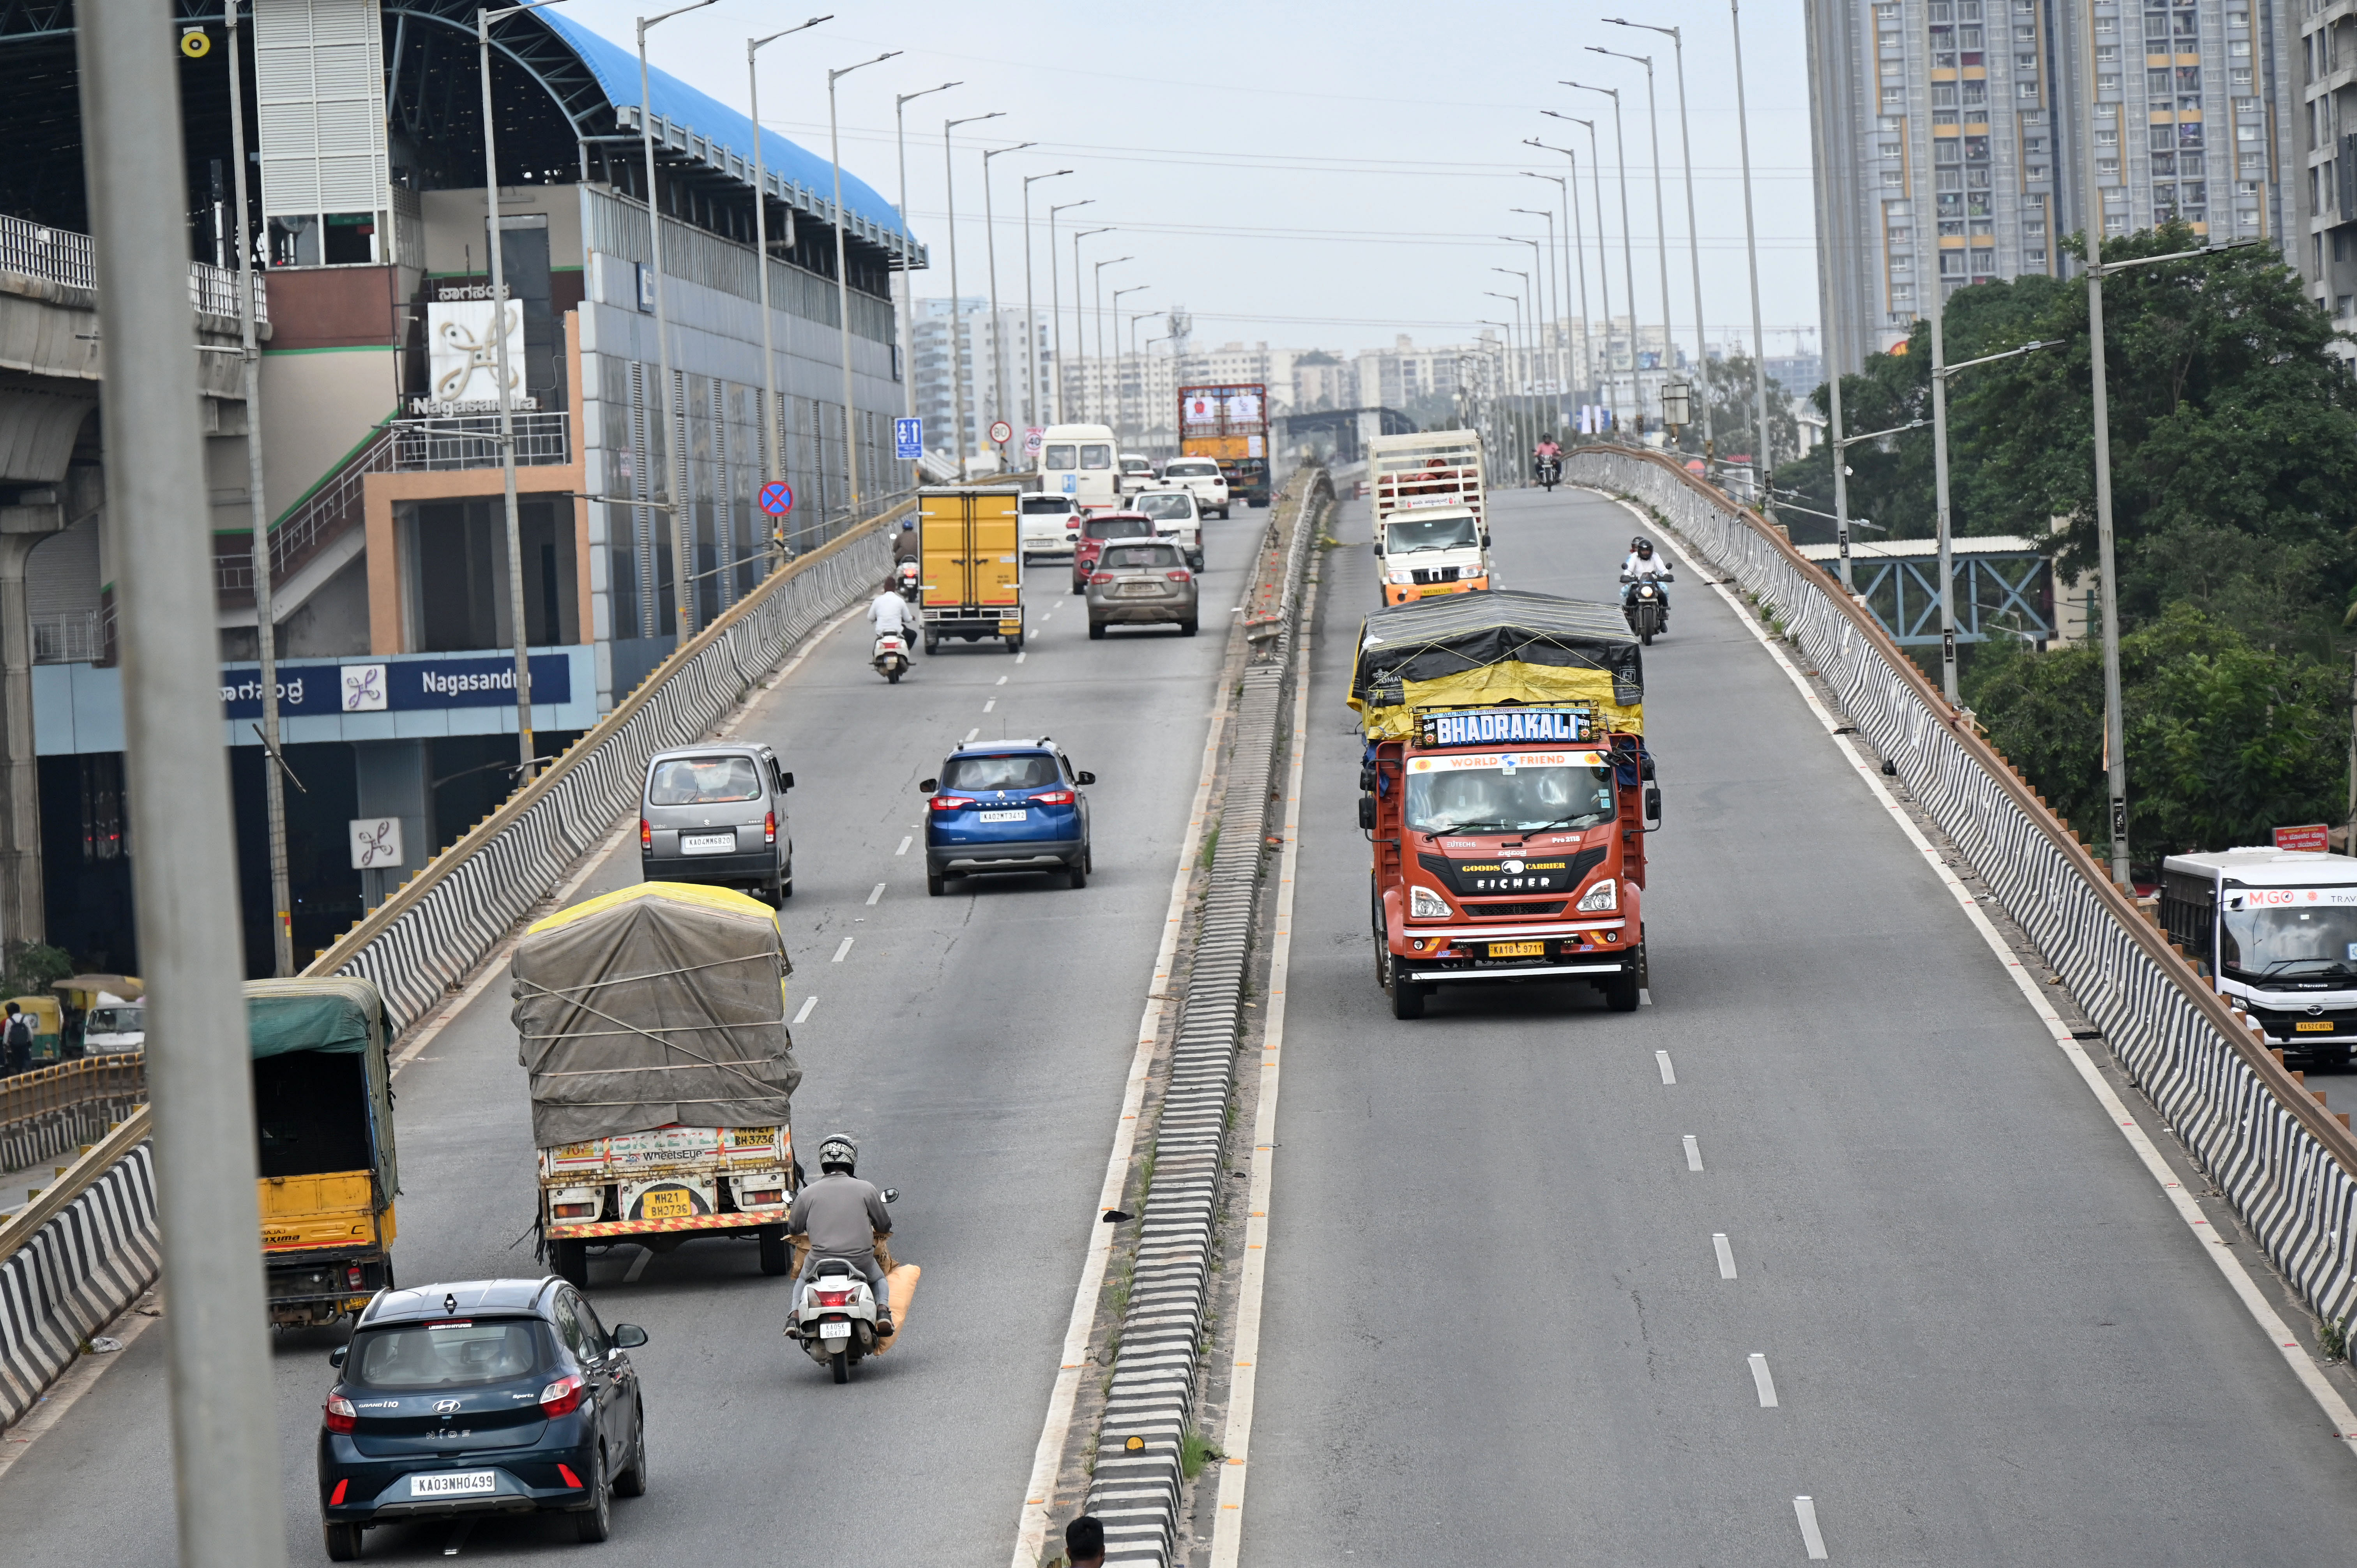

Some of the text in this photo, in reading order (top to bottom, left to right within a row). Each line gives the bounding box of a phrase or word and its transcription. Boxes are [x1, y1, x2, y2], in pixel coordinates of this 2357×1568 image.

[1424, 714, 1590, 745] SRI BHADRAKALI DEVI
[1450, 755, 1565, 767] WORLD FRIEND
[1477, 878, 1550, 890] EICHER
[643, 1150, 702, 1161] WheelsEye
[655, 1193, 678, 1204] MH21
[652, 1204, 688, 1216] BH3736
[351, 1225, 365, 1235] C
[419, 1476, 493, 1492] KA03NH0499
